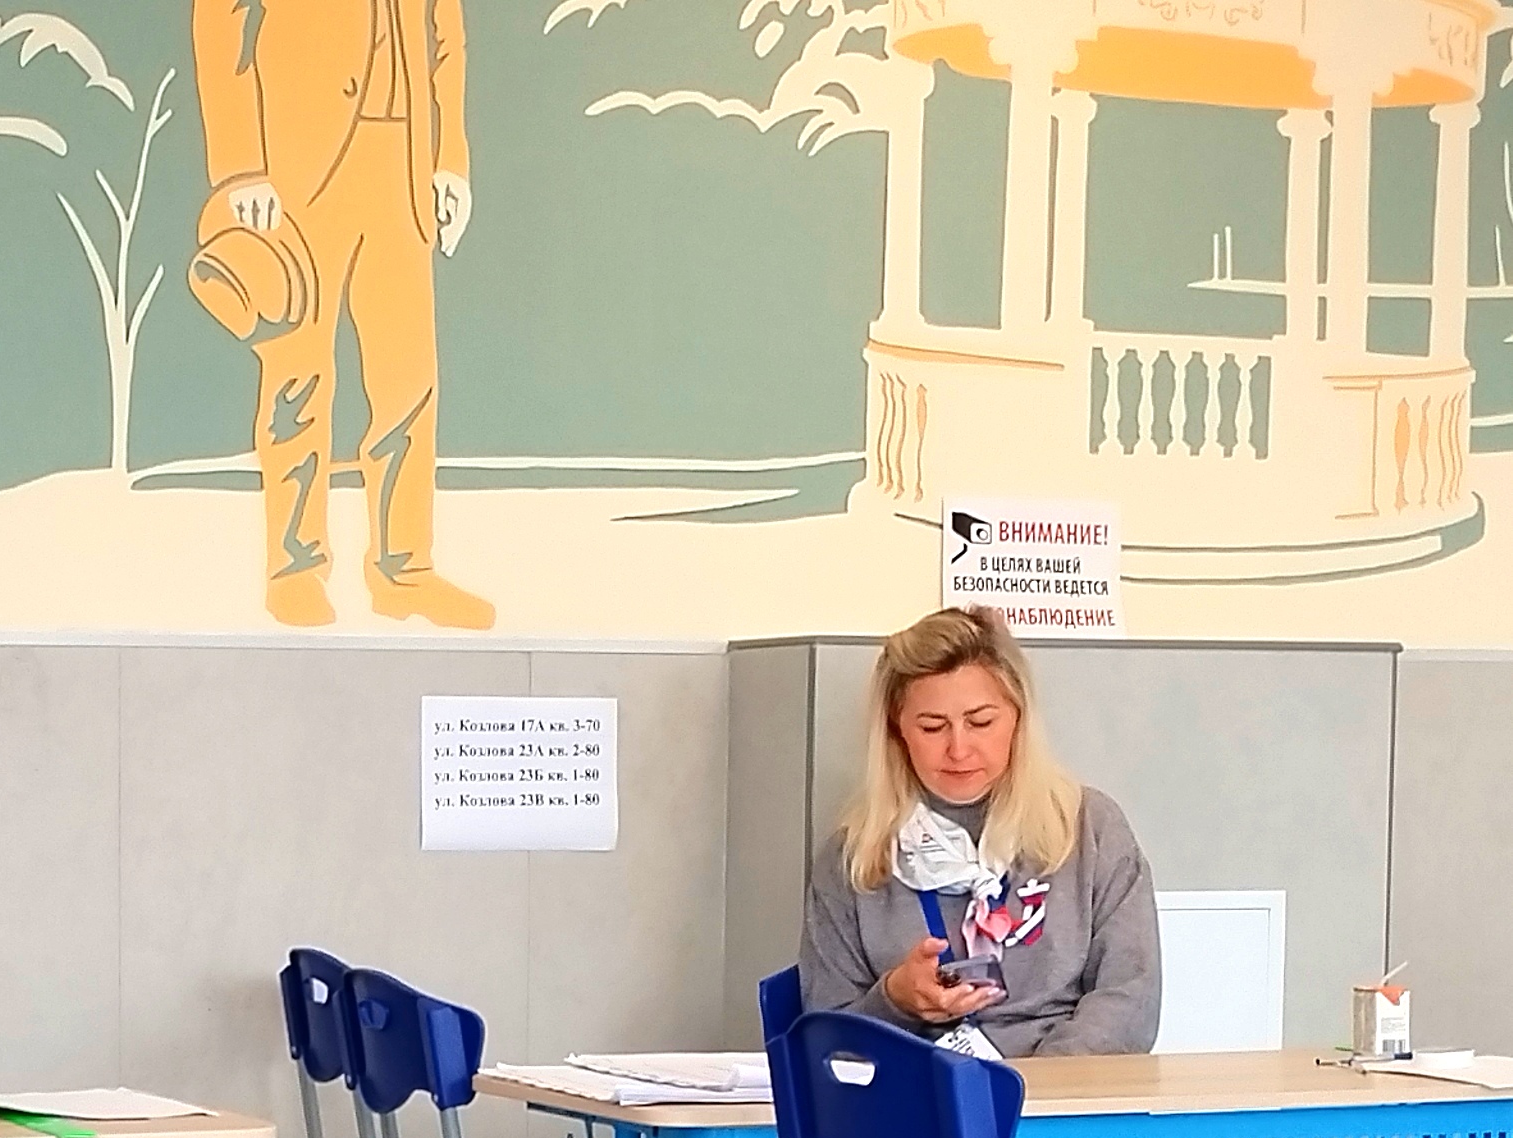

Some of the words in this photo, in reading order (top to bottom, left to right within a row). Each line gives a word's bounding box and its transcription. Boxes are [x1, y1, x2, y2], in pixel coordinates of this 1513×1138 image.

[999, 520, 1109, 546] ВНИМАНИЕ!
[980, 557, 989, 571] В
[991, 557, 1033, 574] ЦЕЛЯХ
[1036, 556, 1081, 574] ВАШЕЙ
[953, 576, 1051, 594] БЕЗОПАСНОСТИ
[1055, 580, 1109, 598] ВЕДЕТСЯ
[1000, 606, 1116, 629] НАБЛЮДЕНИЕ
[433, 722, 454, 735] ул.
[459, 719, 515, 732] Козлова
[520, 720, 545, 732] 17А
[549, 722, 569, 732] кв.
[573, 719, 601, 732] 3-70
[433, 747, 453, 760] ул.
[459, 744, 515, 757] Козлова
[519, 744, 545, 757] 23А
[549, 748, 569, 757] кв.
[573, 744, 601, 757] 2-80
[433, 772, 455, 784] ул.
[459, 769, 515, 782] Козлова
[519, 769, 544, 782] 23Б
[548, 772, 568, 782] кв.
[573, 769, 599, 782] 1-80
[434, 796, 455, 810] ул.
[459, 794, 515, 806] Козлова
[519, 794, 545, 806] 23В
[549, 797, 569, 806] кв.
[573, 794, 600, 806] 1-80
